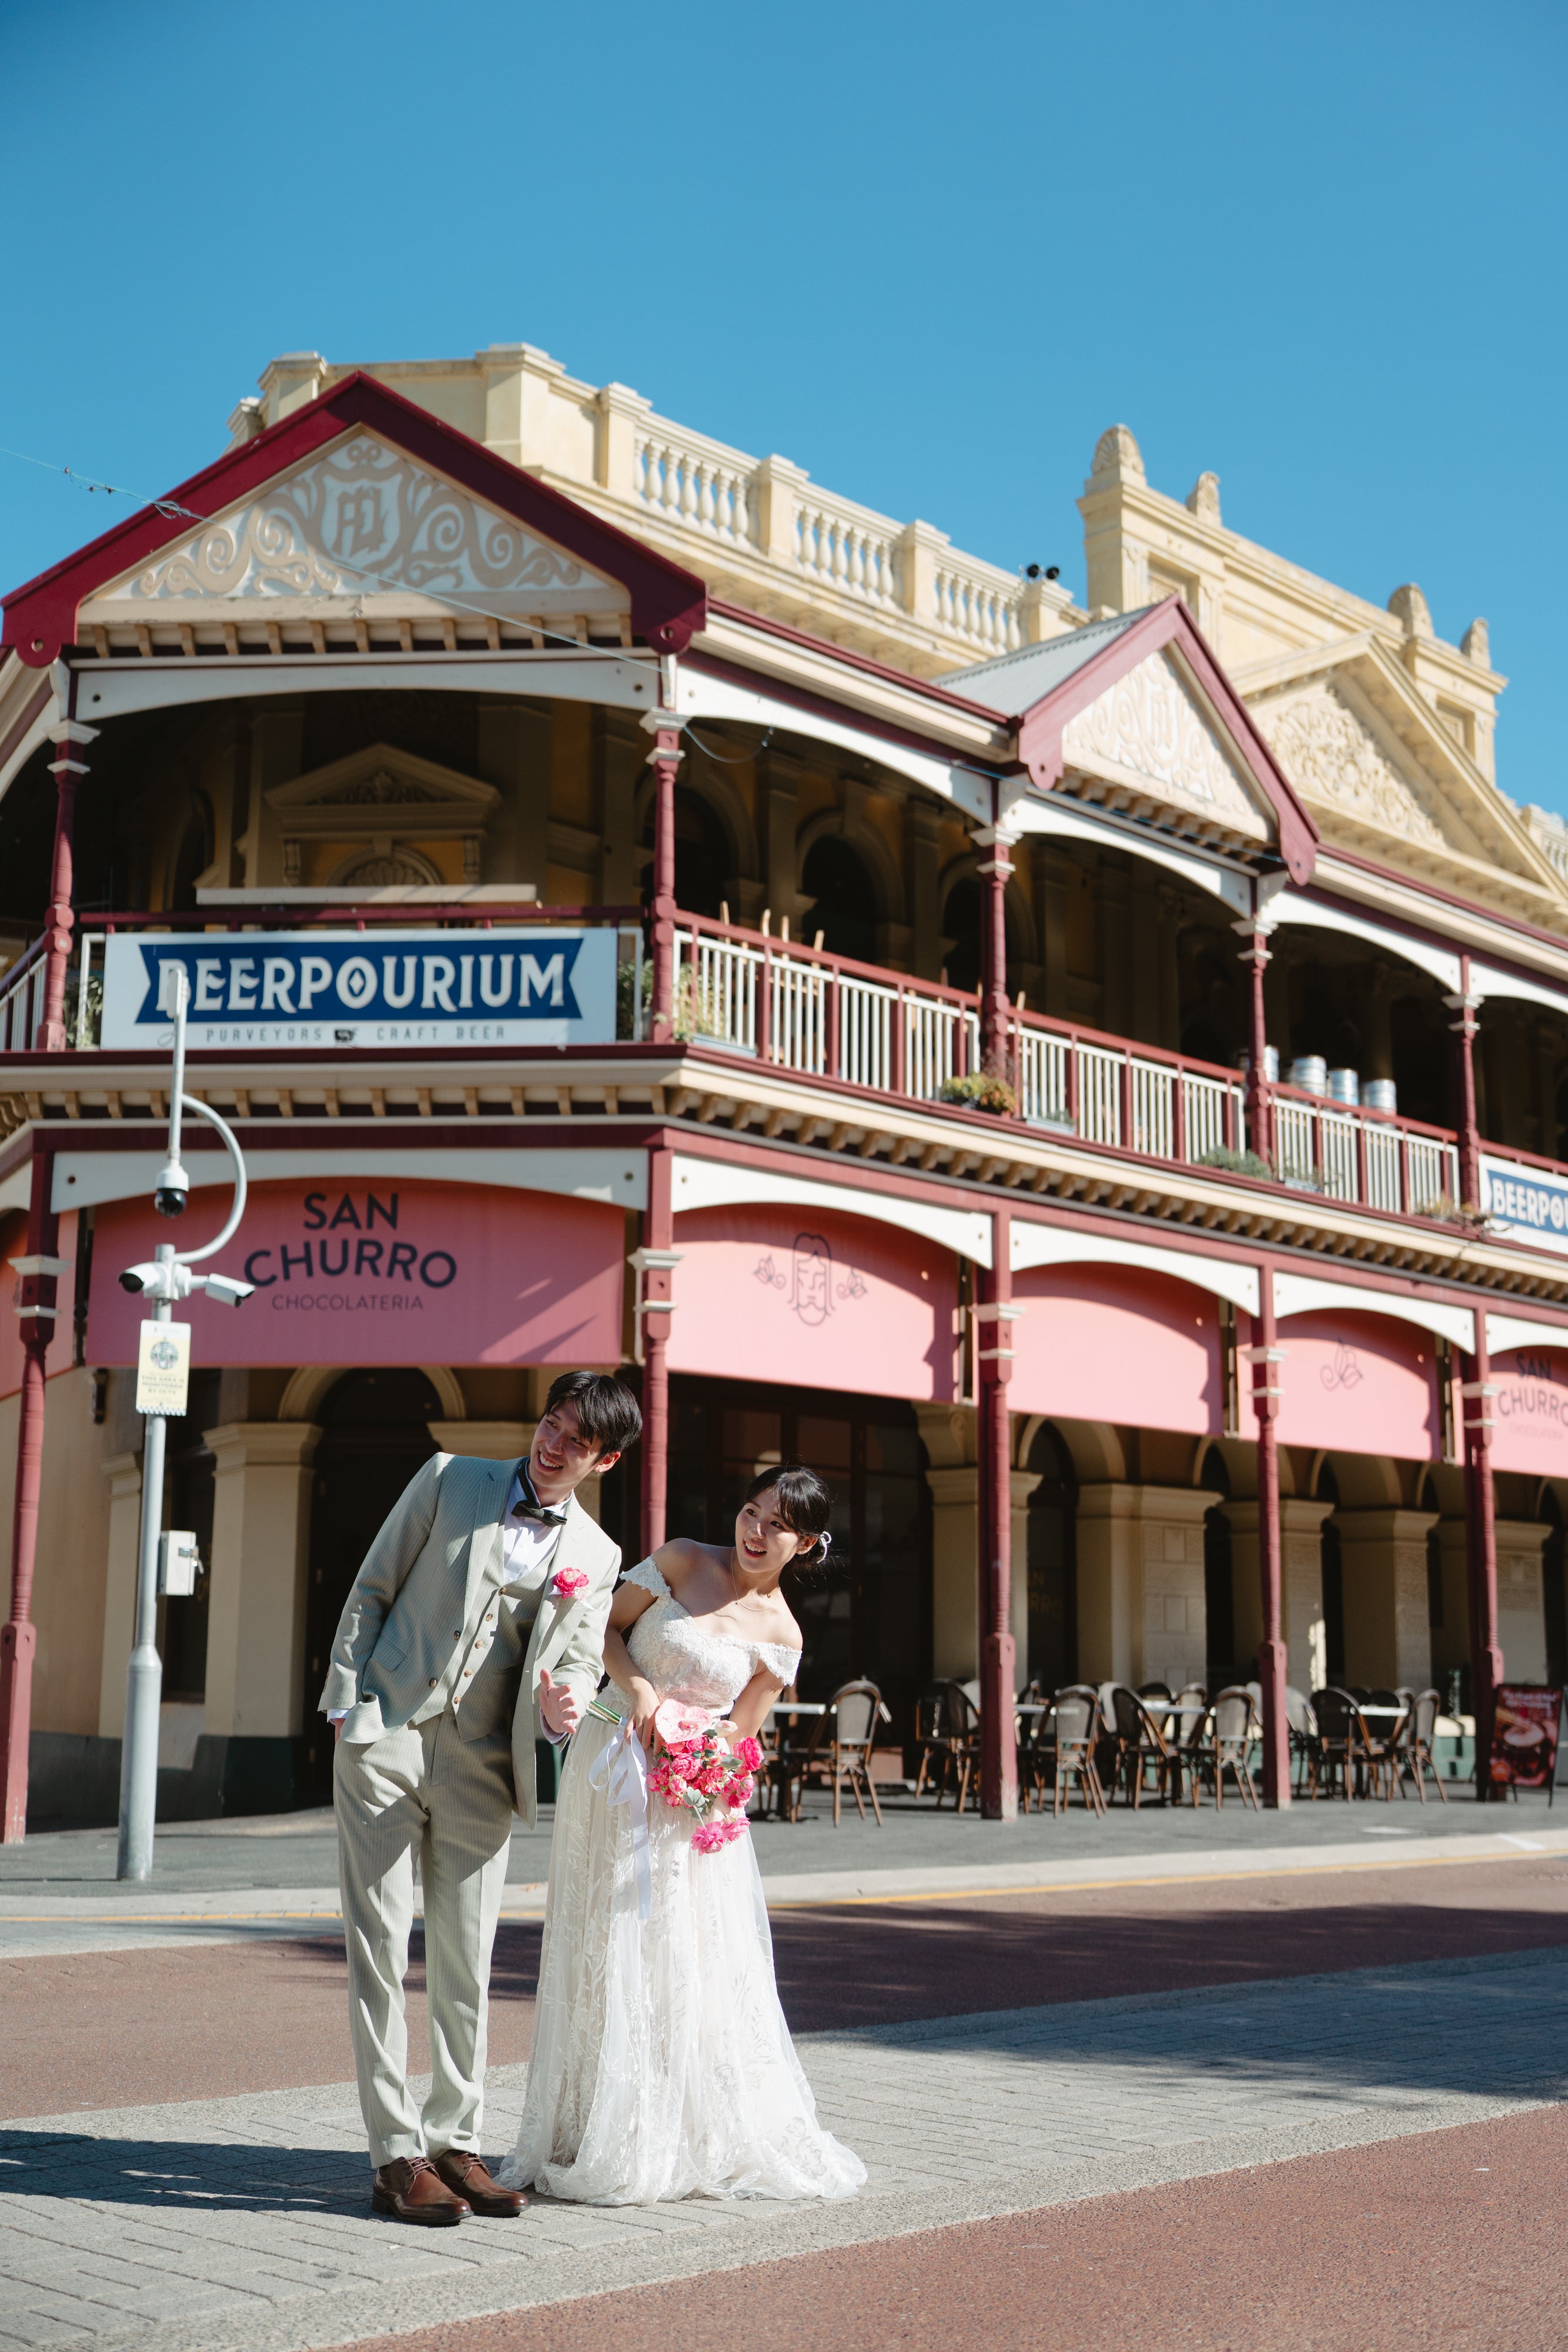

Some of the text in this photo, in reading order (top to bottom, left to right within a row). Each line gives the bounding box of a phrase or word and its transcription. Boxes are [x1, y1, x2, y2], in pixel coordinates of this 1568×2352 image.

[156, 953, 565, 1013] BEERPOURIUM
[206, 1027, 322, 1043] PURVEYORS
[377, 1027, 438, 1041] CRAFT
[456, 1025, 505, 1040] BEER
[303, 1192, 398, 1230] SAN
[1492, 1178, 1568, 1231] BEERPO
[244, 1238, 457, 1288] CHURRO
[271, 1294, 423, 1311] CHOCOLATERIA
[1516, 1352, 1552, 1380] SAN
